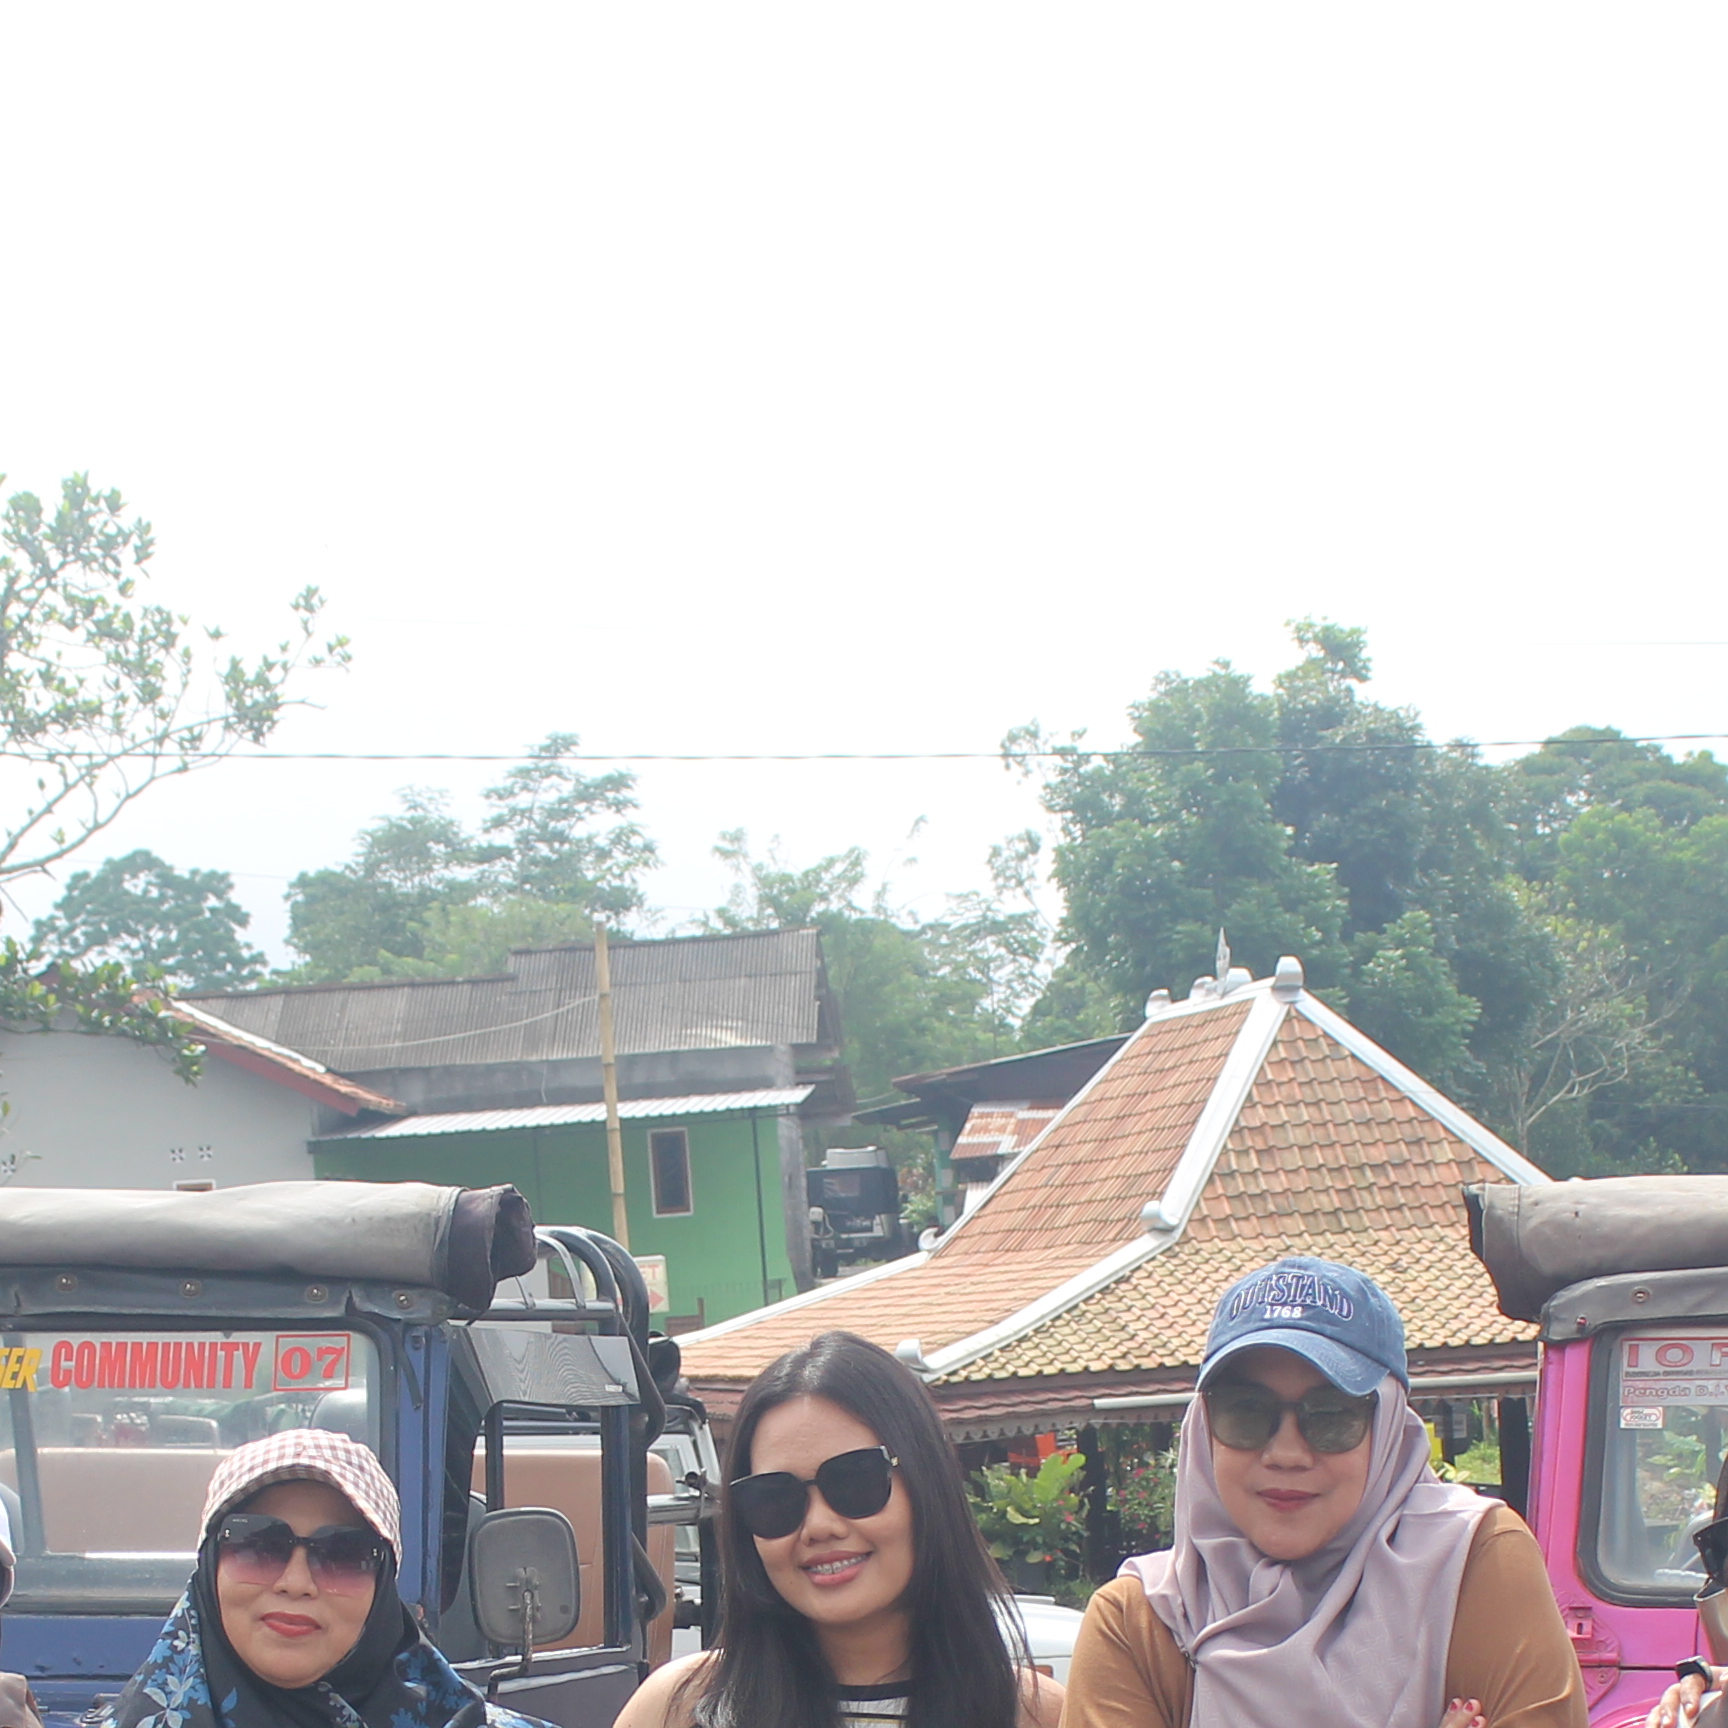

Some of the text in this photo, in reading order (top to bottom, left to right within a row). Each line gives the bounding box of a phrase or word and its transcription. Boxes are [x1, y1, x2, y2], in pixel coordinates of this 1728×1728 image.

[1263, 1305, 1303, 1319] 1768
[50, 1340, 262, 1389] COMMUNITY
[280, 1346, 346, 1380] 07
[1623, 1385, 1691, 1400] Pengda
